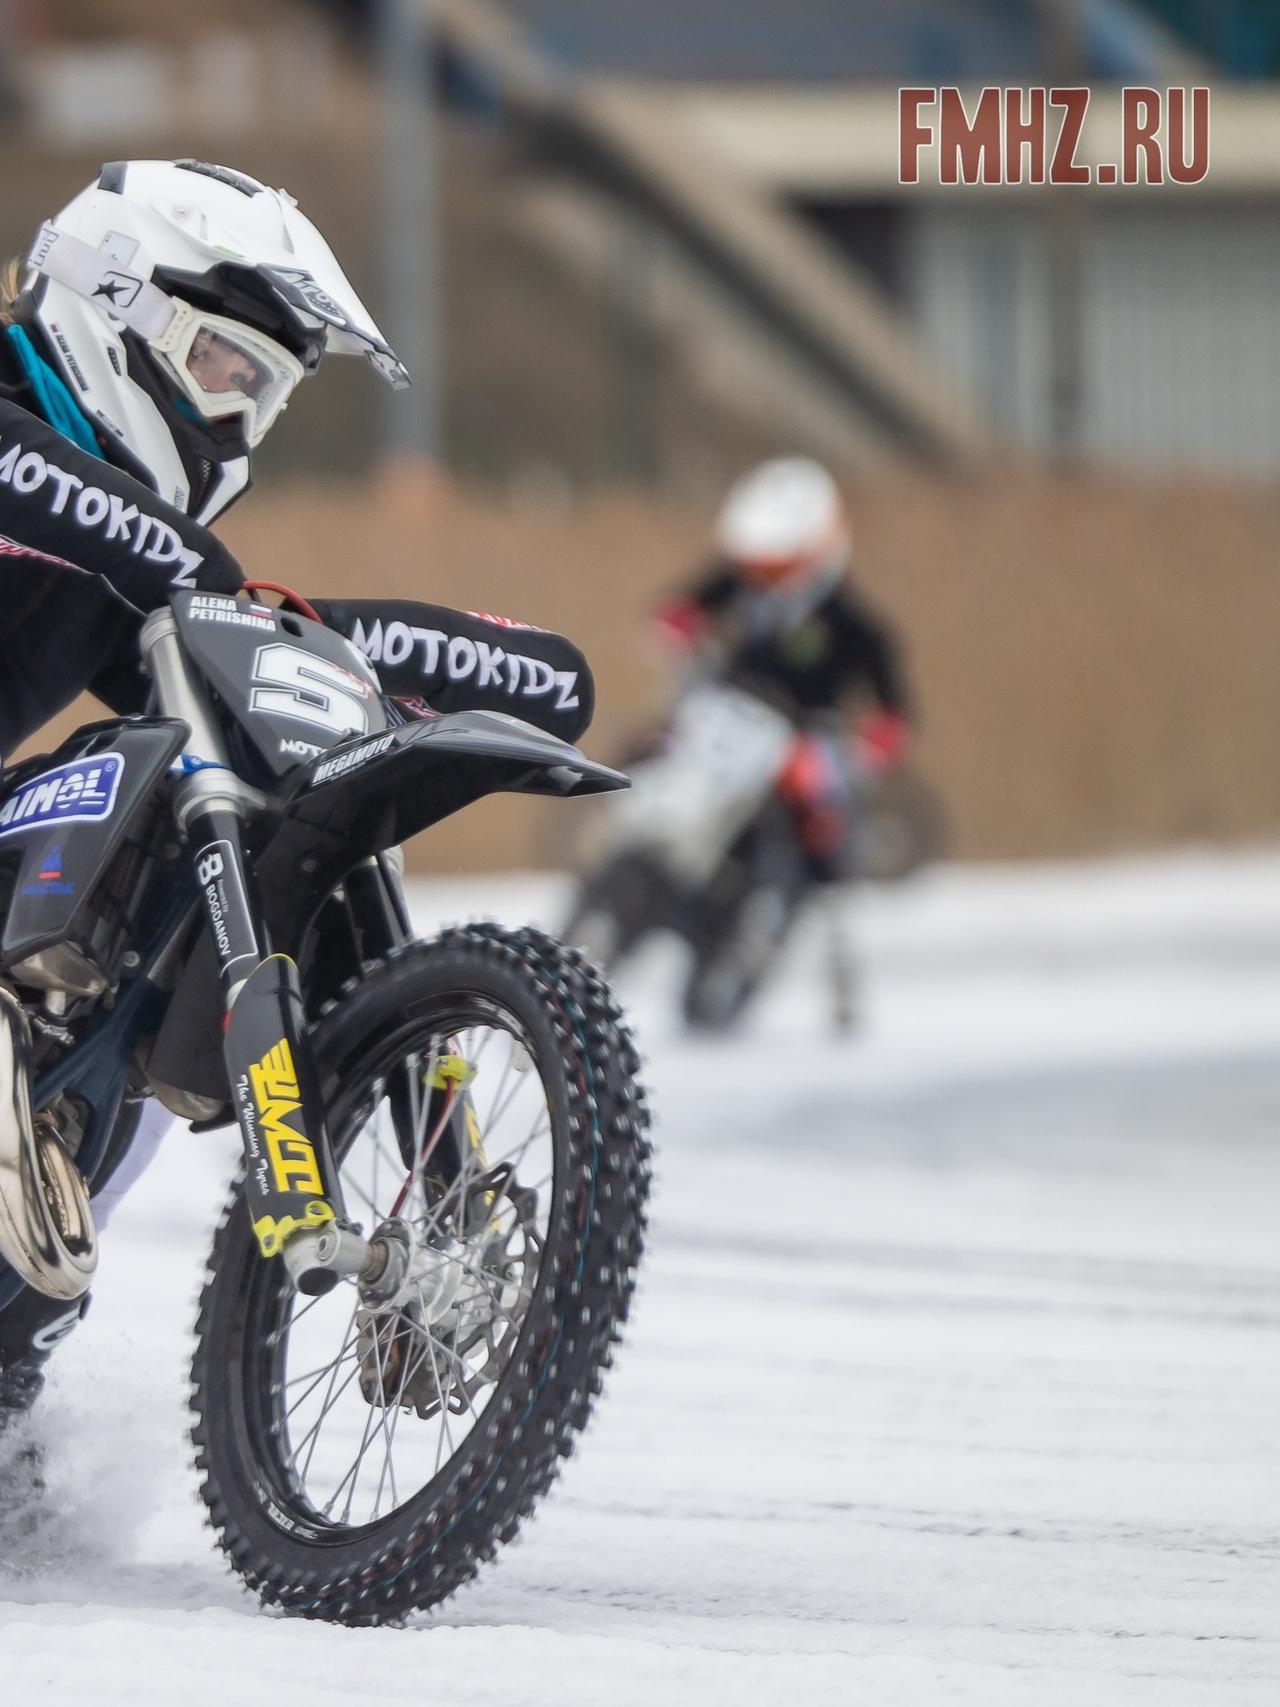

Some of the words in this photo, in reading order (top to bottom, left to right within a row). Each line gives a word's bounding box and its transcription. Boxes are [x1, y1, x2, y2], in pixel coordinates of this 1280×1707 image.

[189, 607, 276, 631] PETRISHINA
[190, 596, 237, 611] ALENA
[249, 642, 372, 735] 5
[351, 618, 580, 709] MOTOKIDZ
[312, 733, 396, 784] MEGAMOTO
[206, 884, 231, 955] BOGDANOV
[236, 1074, 249, 1101] The
[242, 1102, 260, 1158] Winning
[255, 1158, 270, 1196] Tyres
